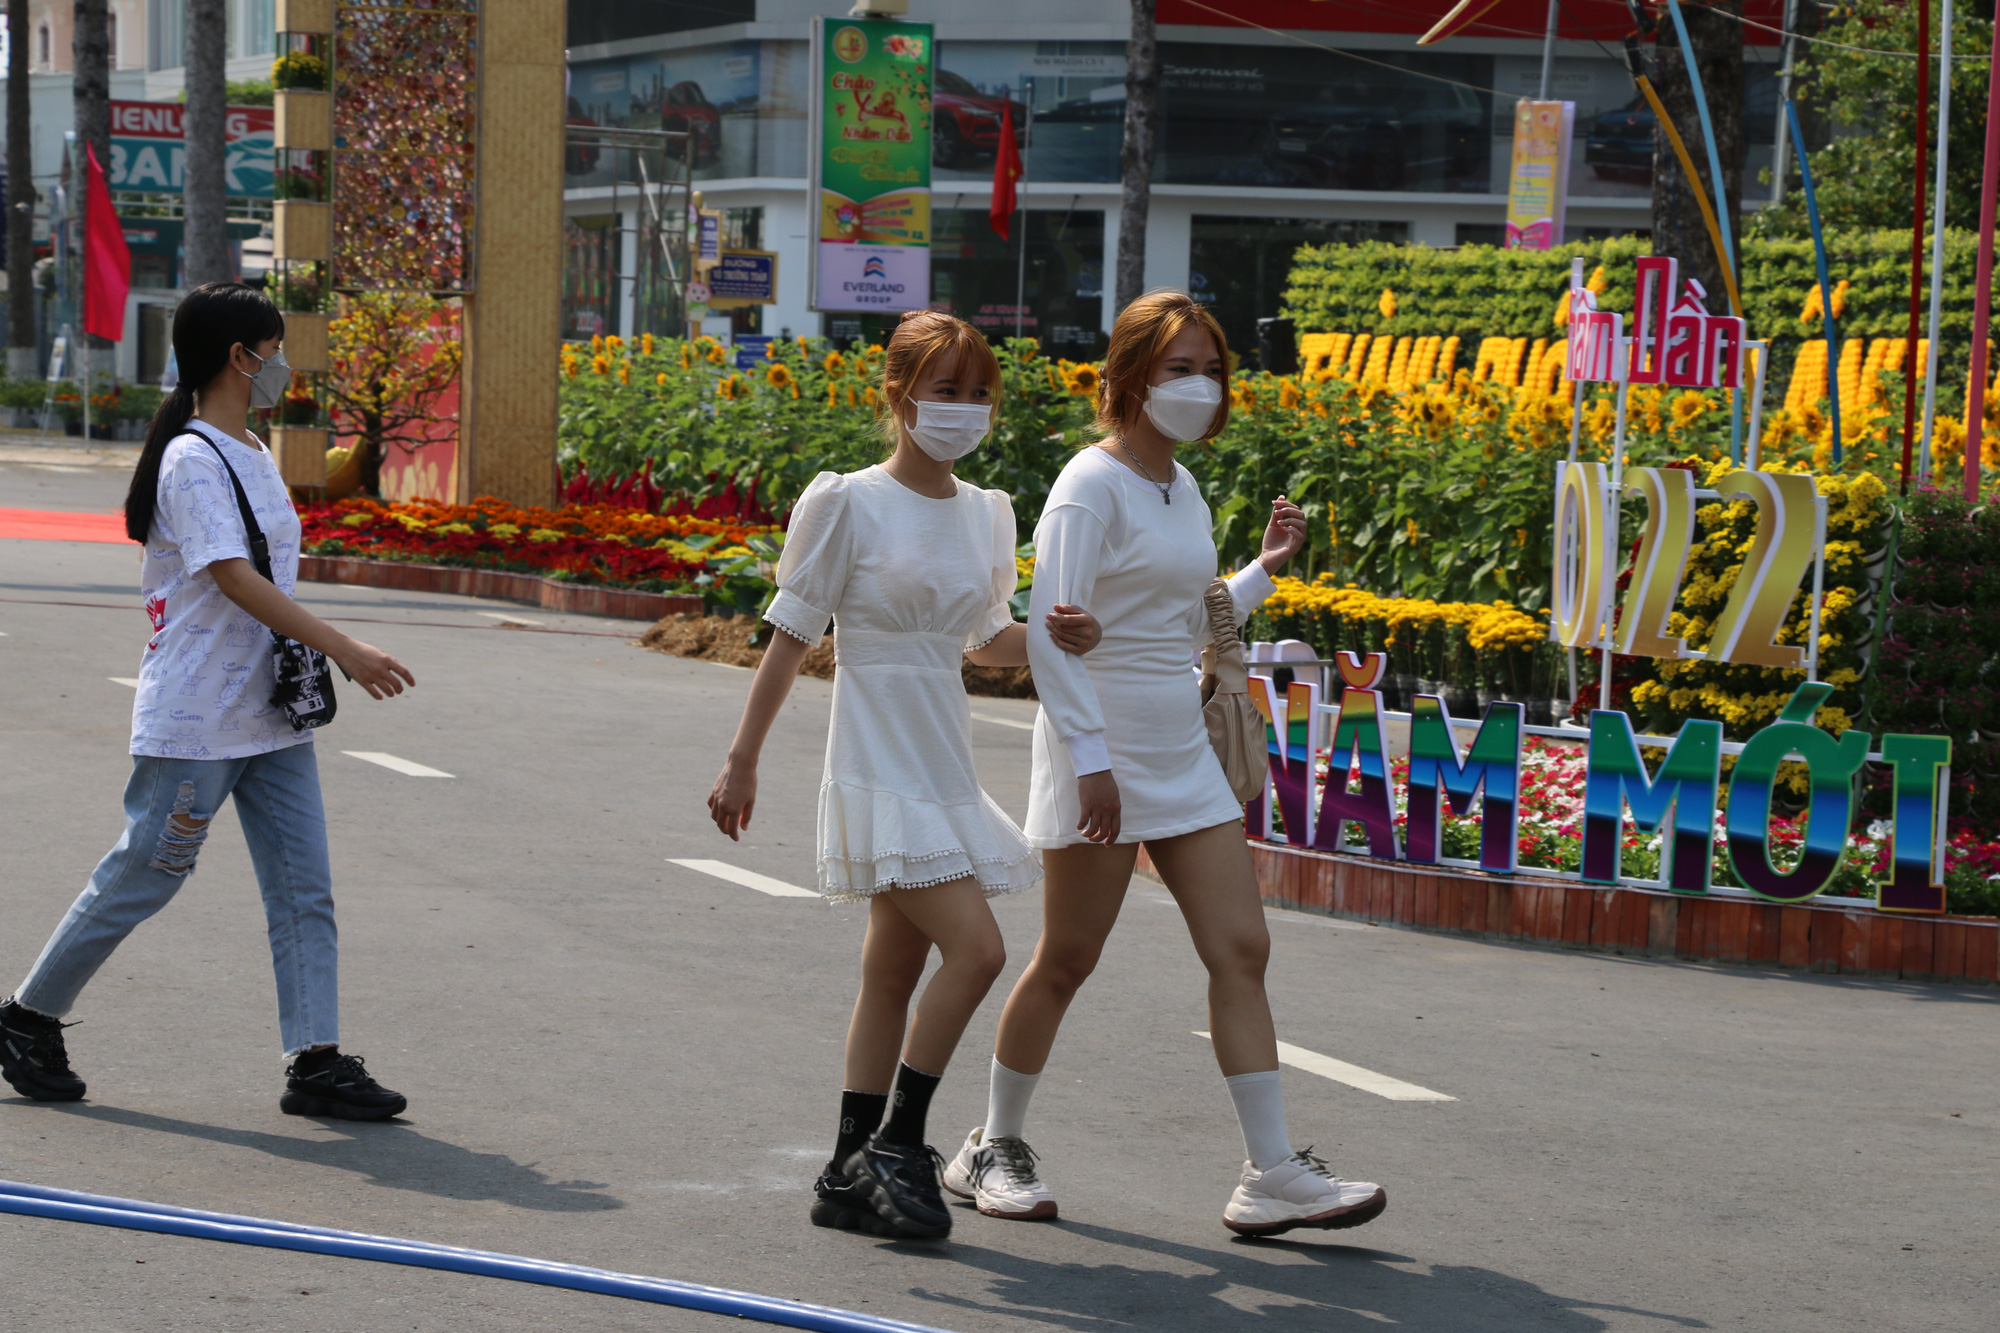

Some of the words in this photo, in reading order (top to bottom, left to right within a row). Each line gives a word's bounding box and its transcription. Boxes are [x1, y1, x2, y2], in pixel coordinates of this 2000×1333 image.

[843, 281, 905, 294] EVERLAND
[855, 295, 892, 304] GROUP
[1627, 256, 1746, 388] Dần
[1245, 651, 1525, 874] NĂM
[1580, 681, 1952, 914] MỚI
